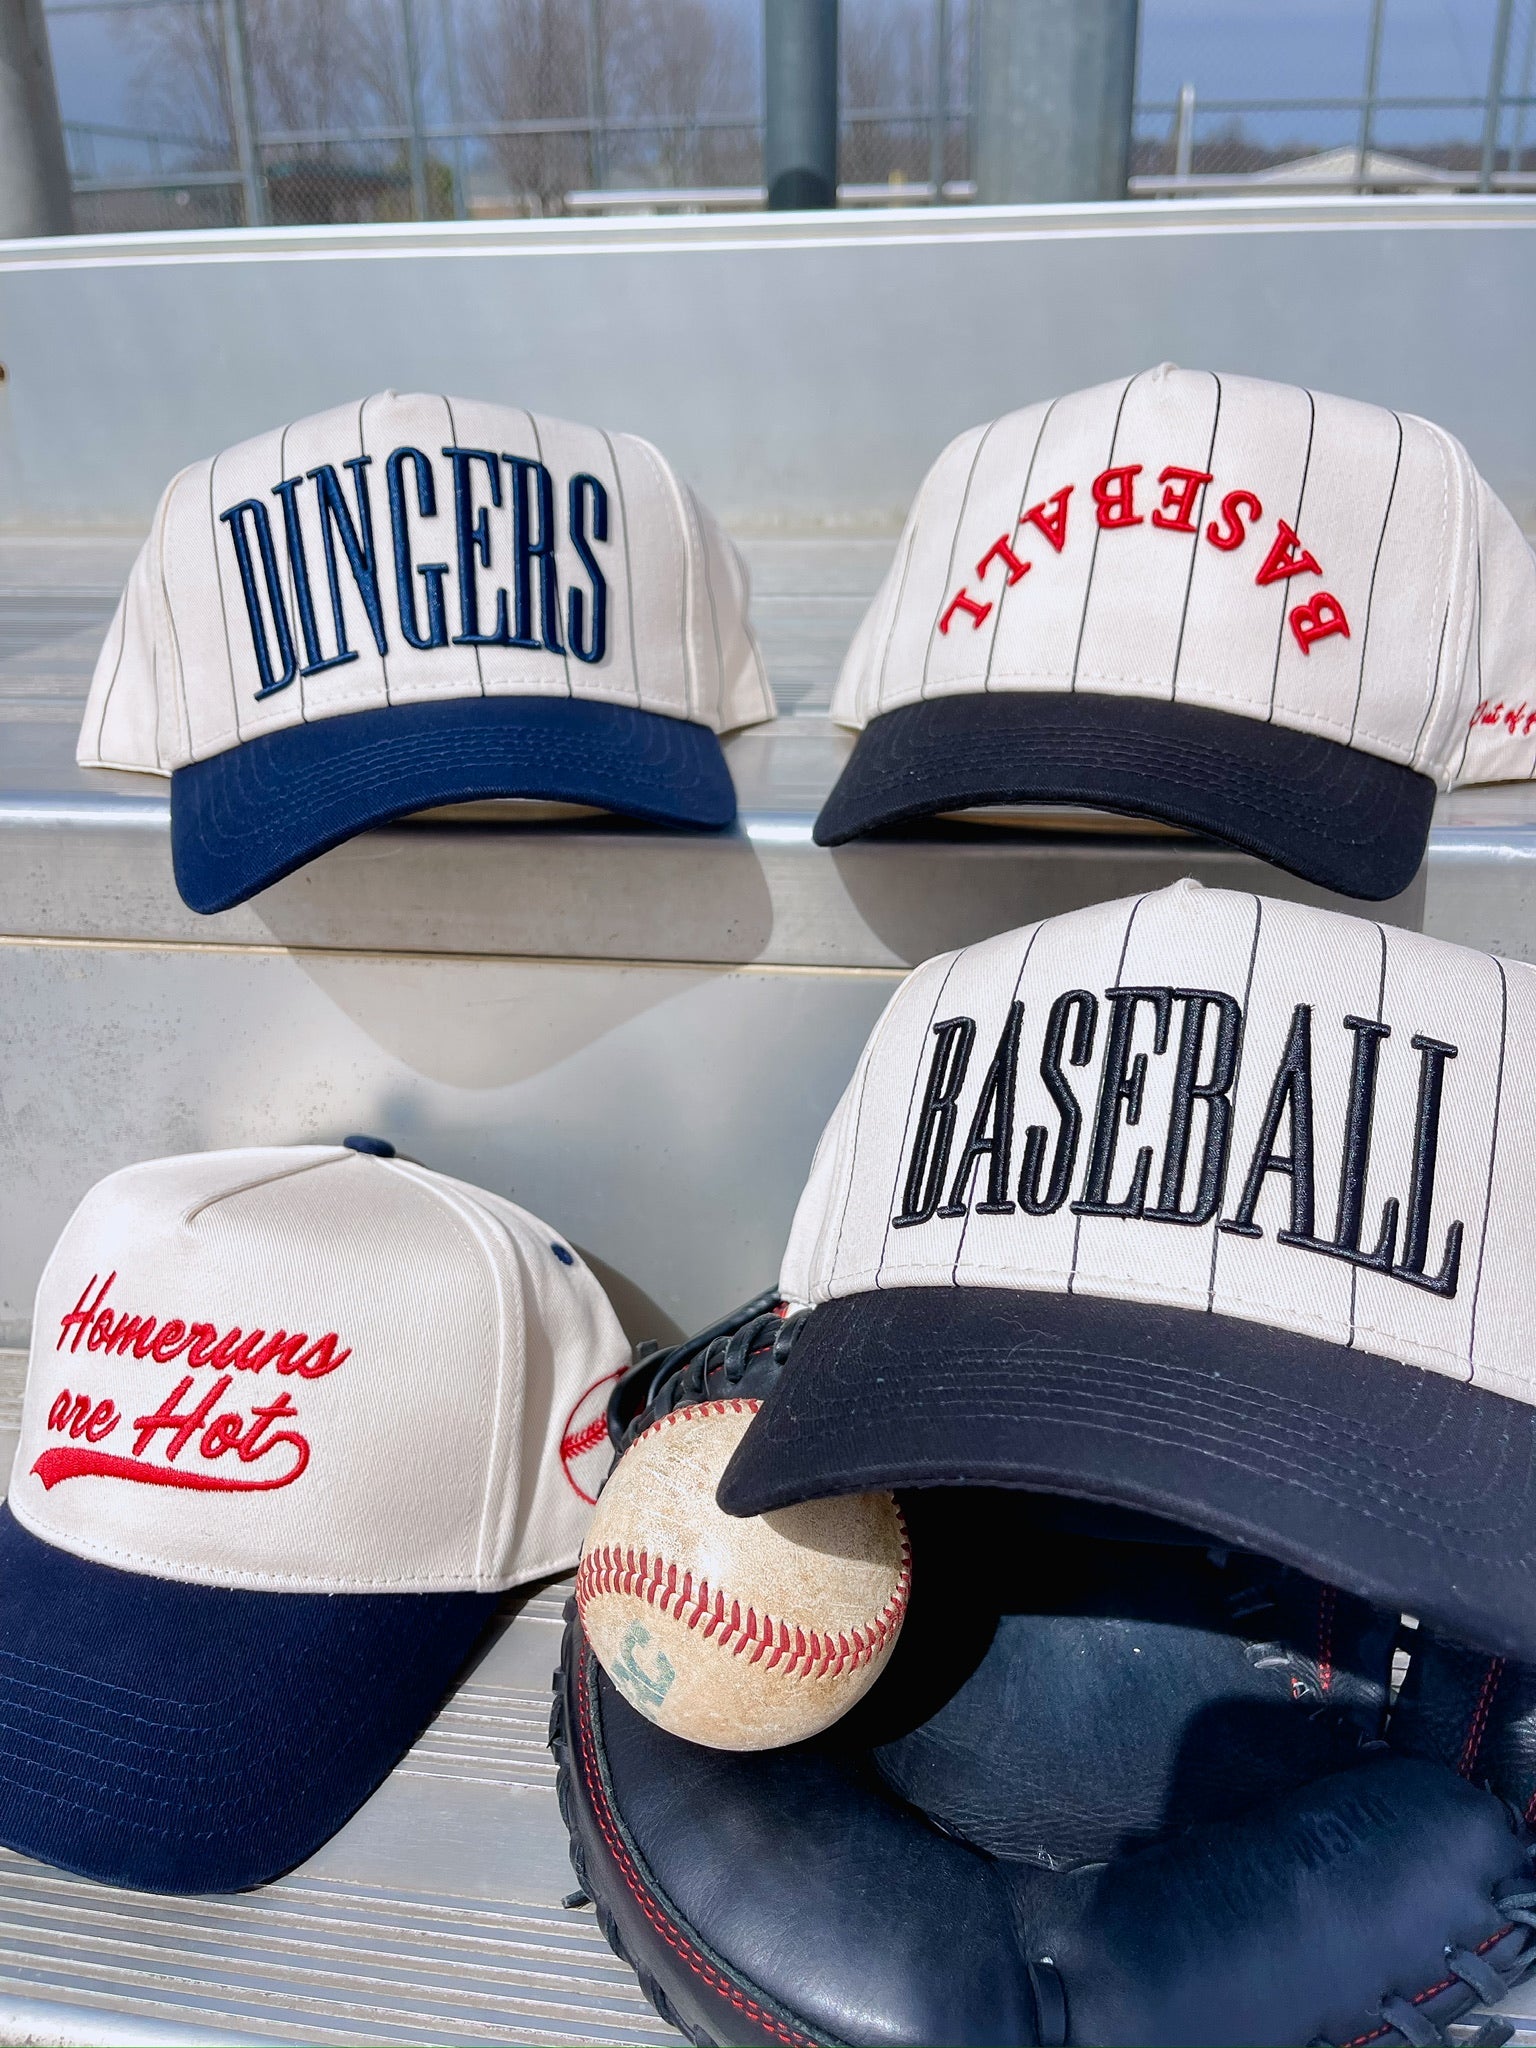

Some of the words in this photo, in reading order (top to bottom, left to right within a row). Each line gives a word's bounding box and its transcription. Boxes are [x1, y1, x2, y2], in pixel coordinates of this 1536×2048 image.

[219, 446, 609, 701] DINGERS
[938, 464, 1352, 656] BASEBALL
[892, 986, 1463, 1299] BASEBALL
[48, 1389, 122, 1443] are
[132, 1374, 305, 1463] Hot
[57, 1270, 353, 1379] Homeruns
